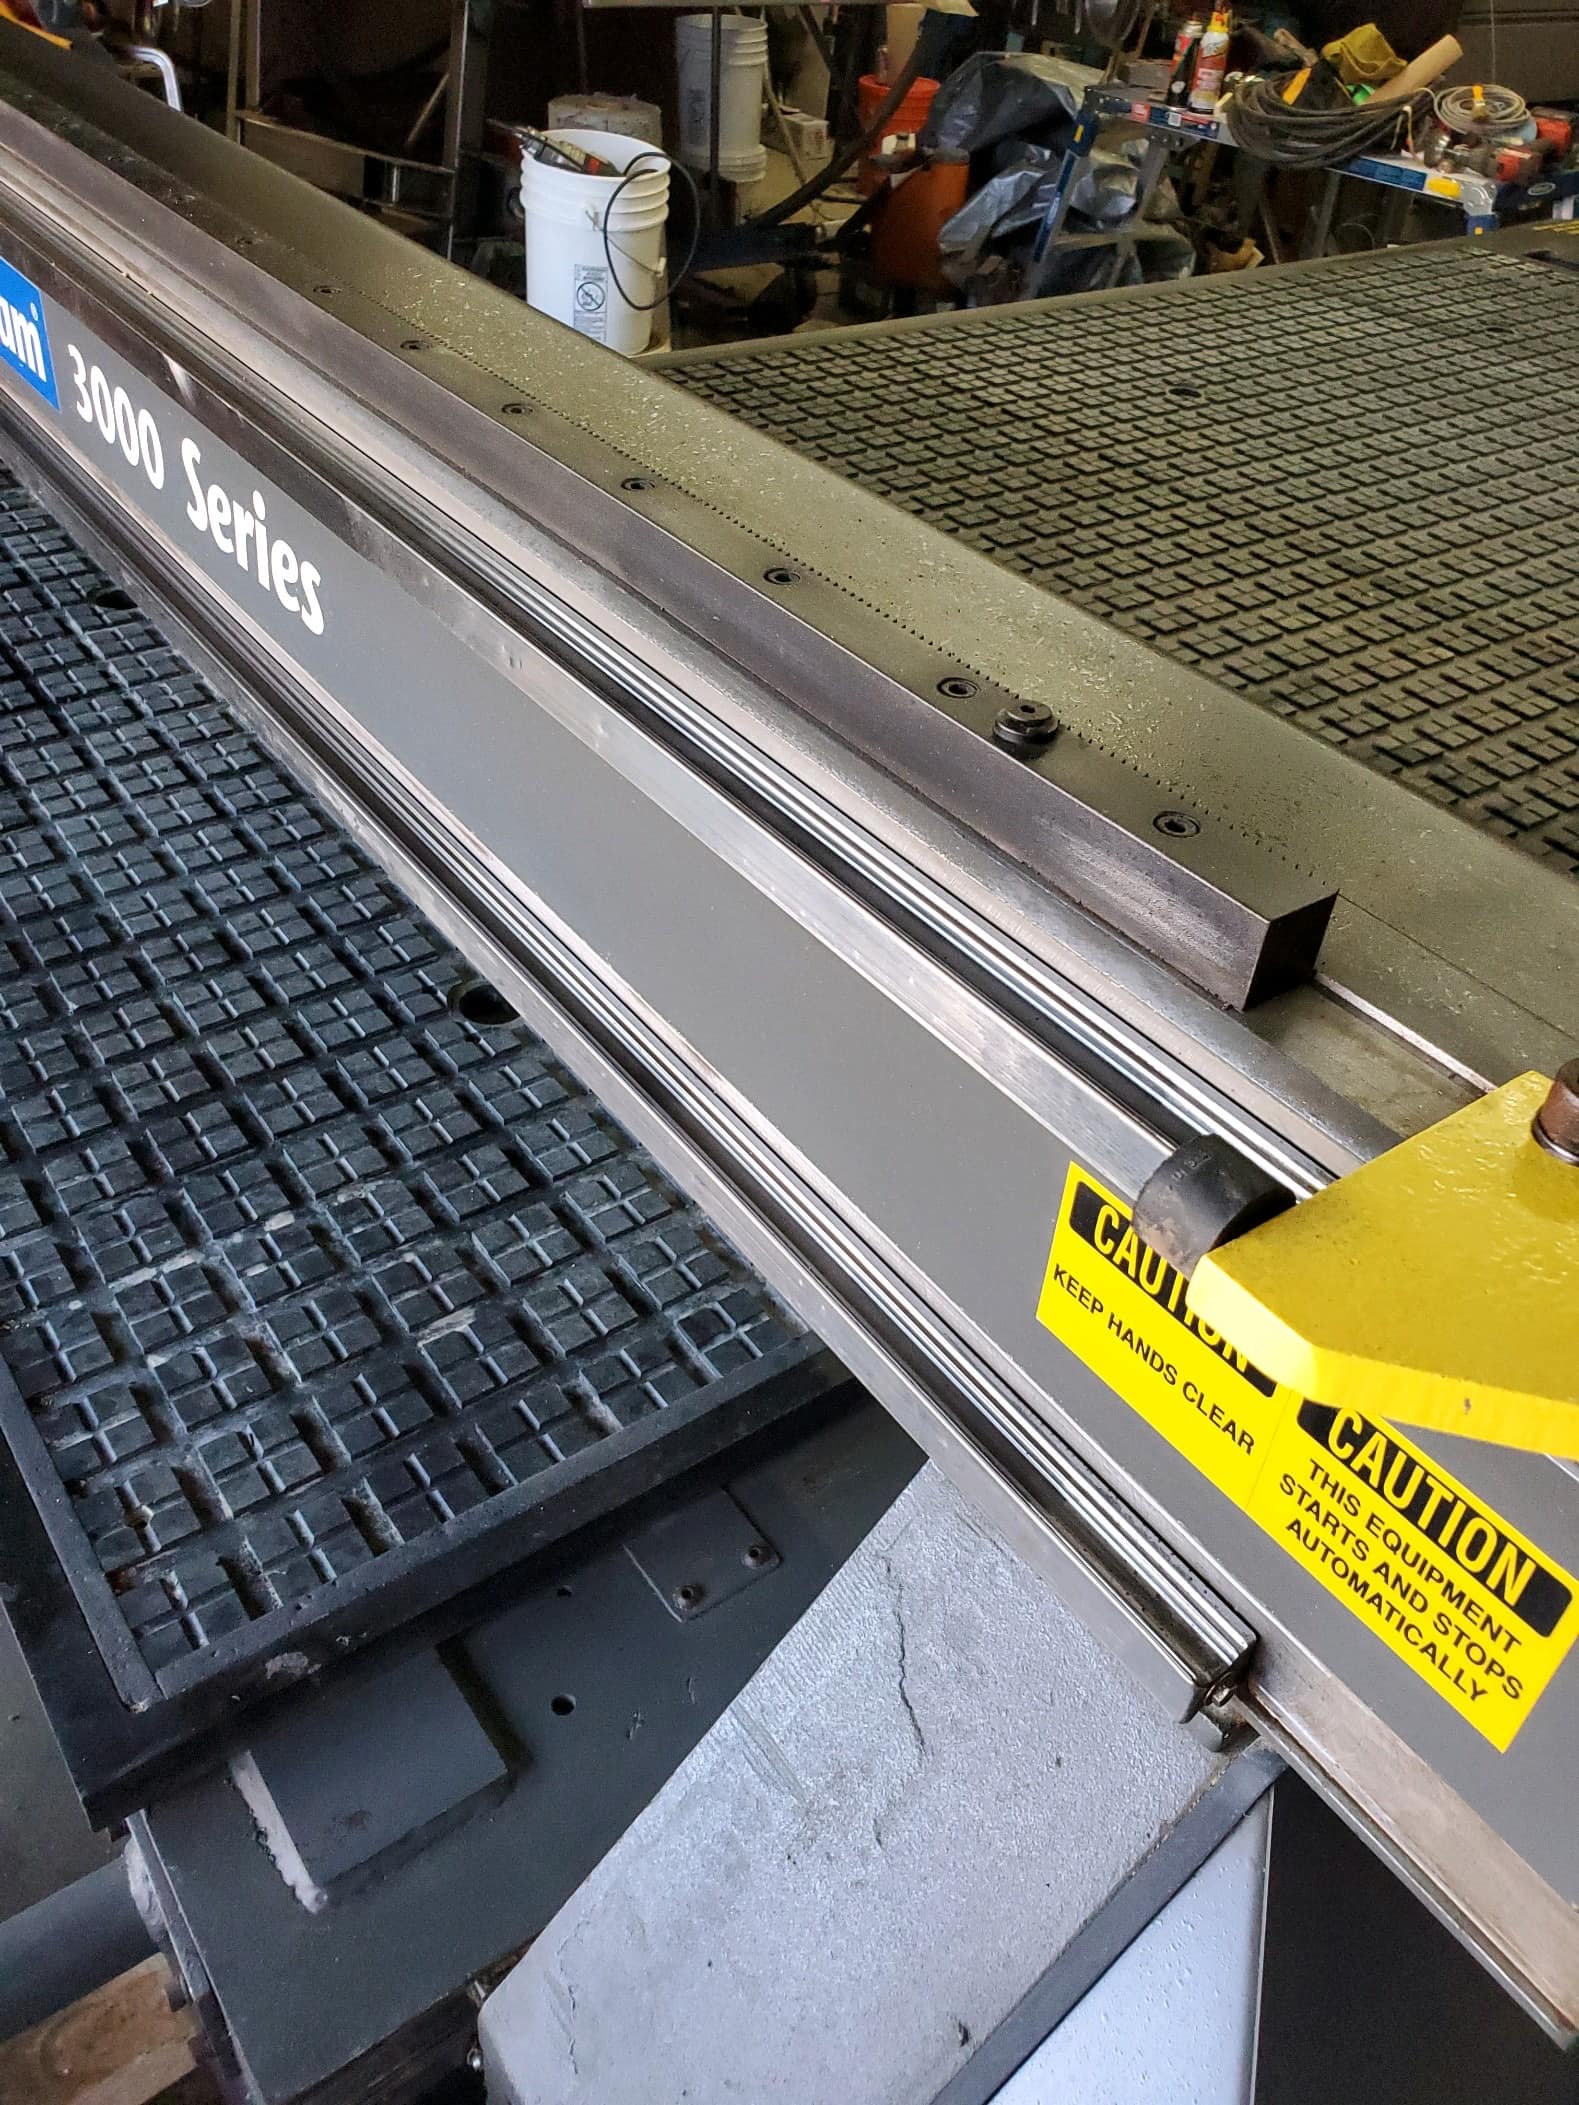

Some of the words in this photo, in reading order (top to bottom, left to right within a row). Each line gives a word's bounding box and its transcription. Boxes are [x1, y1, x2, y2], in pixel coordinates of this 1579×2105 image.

[67, 344, 165, 490] 3000
[181, 437, 325, 636] Series
[1053, 1263, 1104, 1315] KEEP
[1107, 1311, 1178, 1386] HANDS
[1182, 1381, 1255, 1456] CLEAR
[1279, 1472, 1369, 1562] STARTS
[1373, 1561, 1429, 1614] AND
[1432, 1612, 1524, 1700] STOPS
[1308, 1458, 1361, 1517] THIS
[1365, 1512, 1522, 1654] EQUIPMENT
[1327, 1407, 1537, 1608] CAUTION
[1286, 1518, 1488, 1702] AUTOMATICALLY
